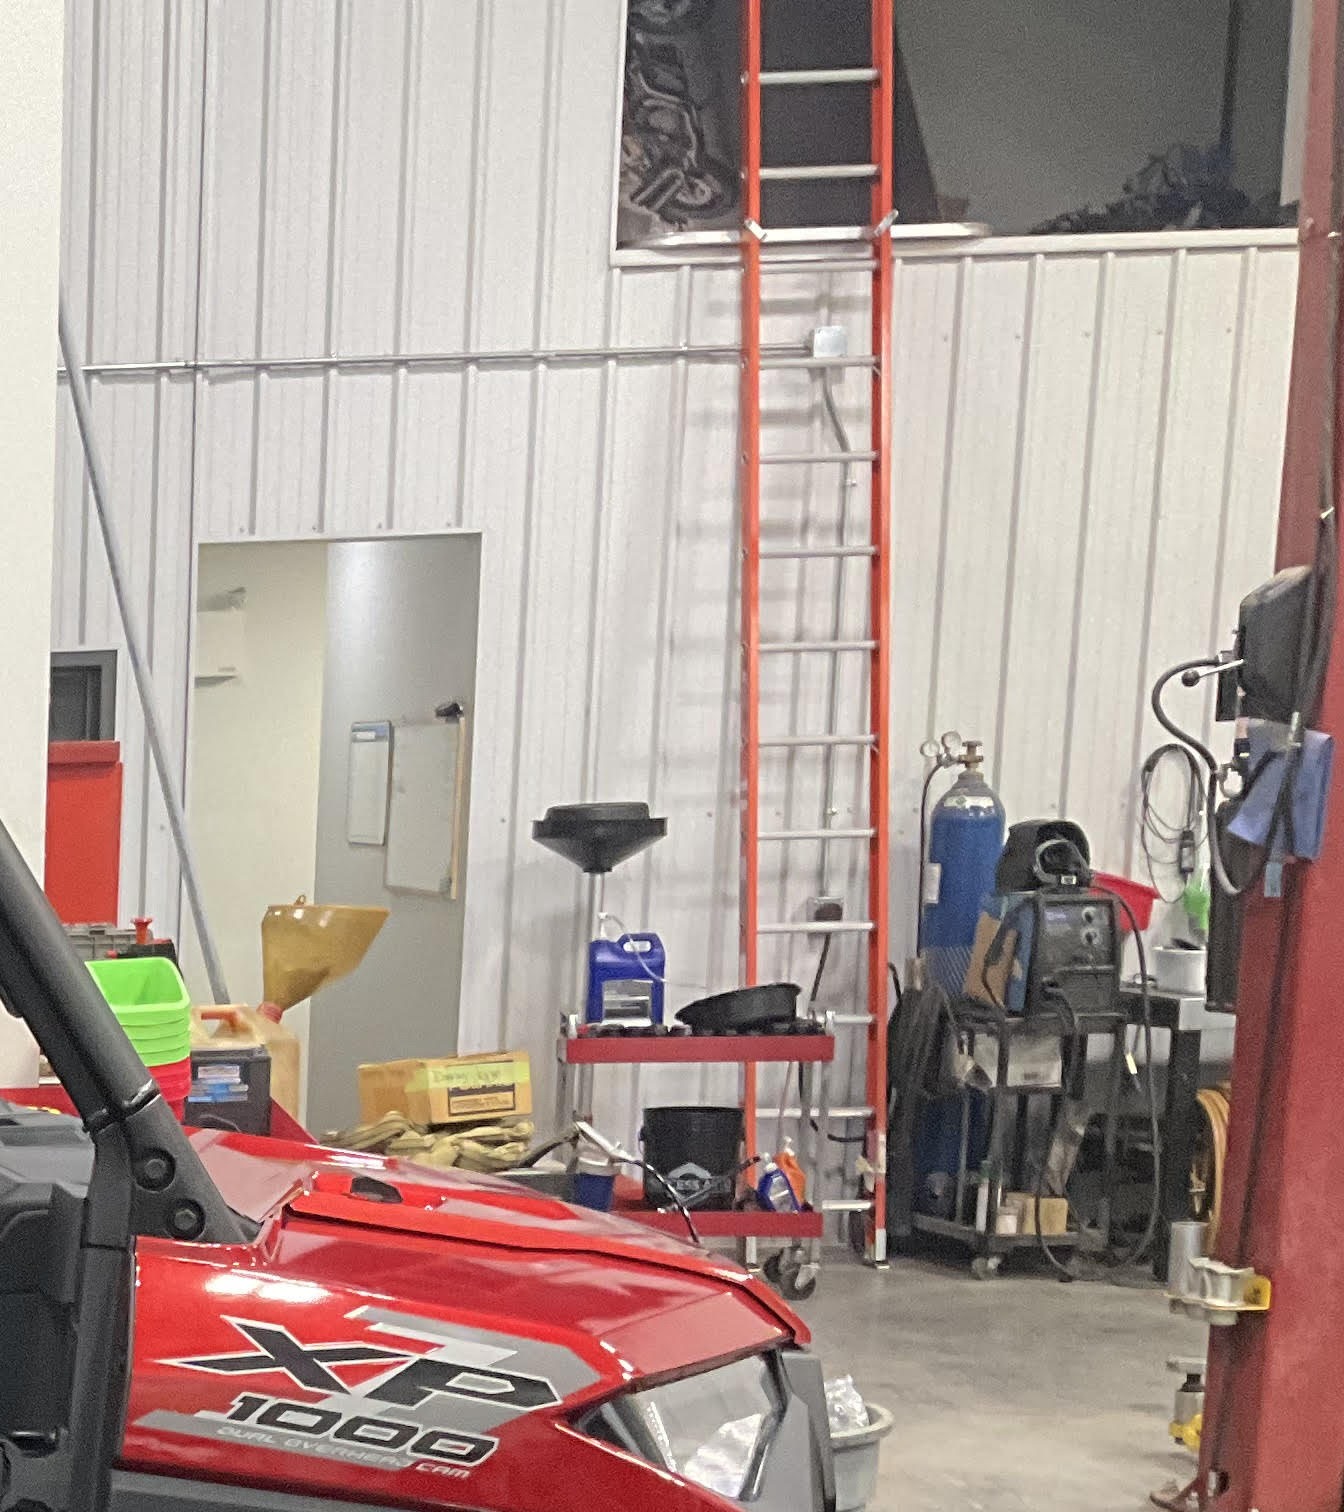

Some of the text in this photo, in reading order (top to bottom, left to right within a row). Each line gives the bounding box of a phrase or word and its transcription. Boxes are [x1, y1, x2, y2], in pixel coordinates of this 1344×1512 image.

[156, 1314, 563, 1410] XP
[216, 1425, 276, 1444] DUAL
[415, 1462, 471, 1479] CAM
[226, 1393, 499, 1466] 1000
